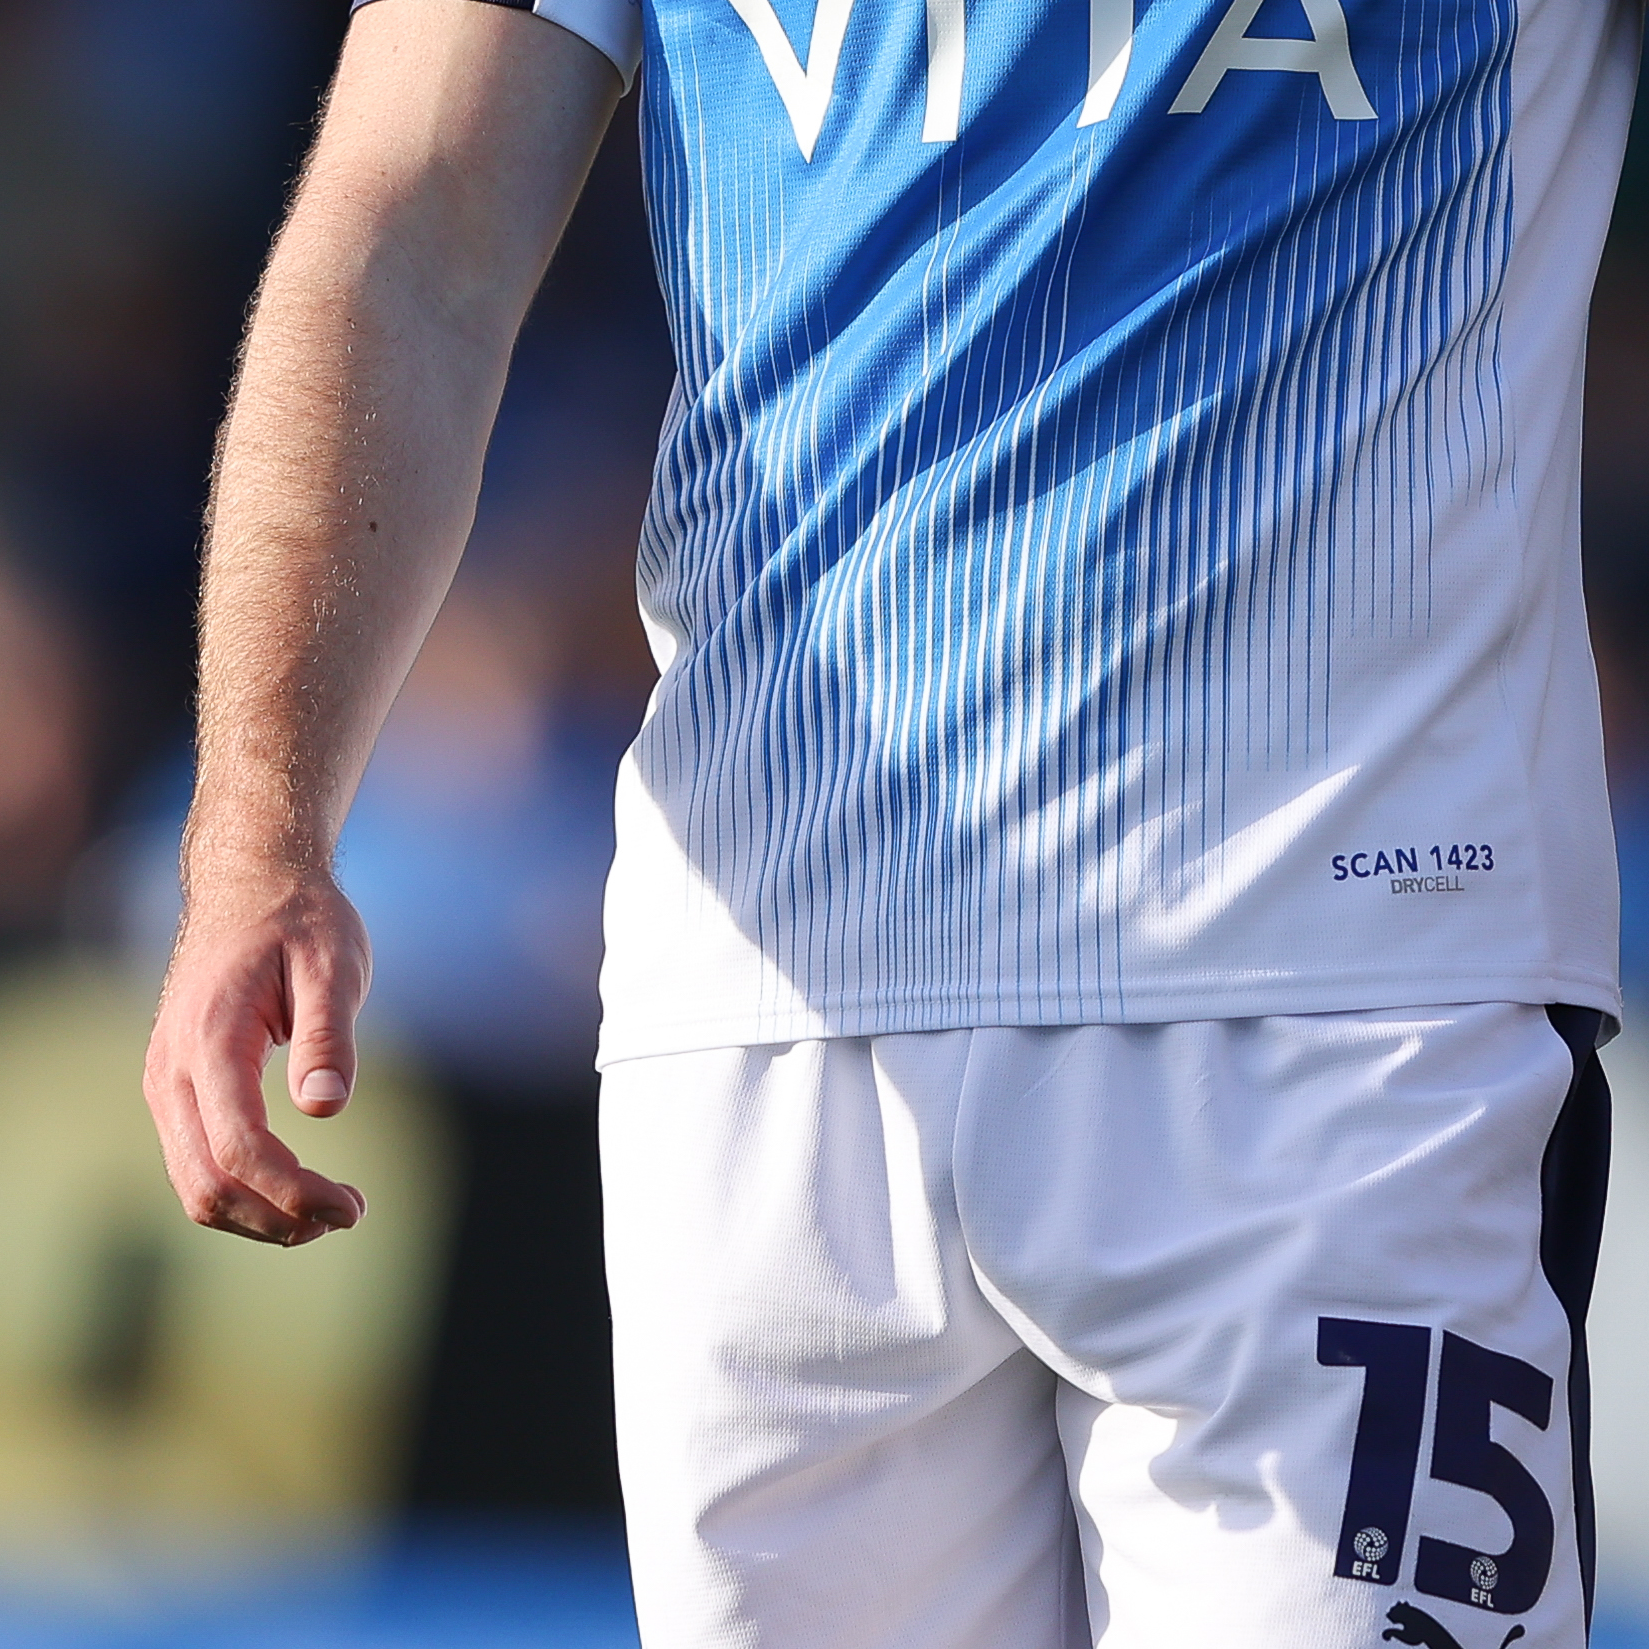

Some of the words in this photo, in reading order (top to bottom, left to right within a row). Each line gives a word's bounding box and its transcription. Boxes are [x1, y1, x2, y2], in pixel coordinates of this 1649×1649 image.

[1332, 847, 1419, 881] SCAN
[1429, 844, 1495, 871] 1423
[1391, 876, 1465, 894] DRYCELL
[1316, 1316, 1555, 1615] 15
[1352, 1561, 1380, 1580] EFL
[1470, 1588, 1494, 1608] EFL
